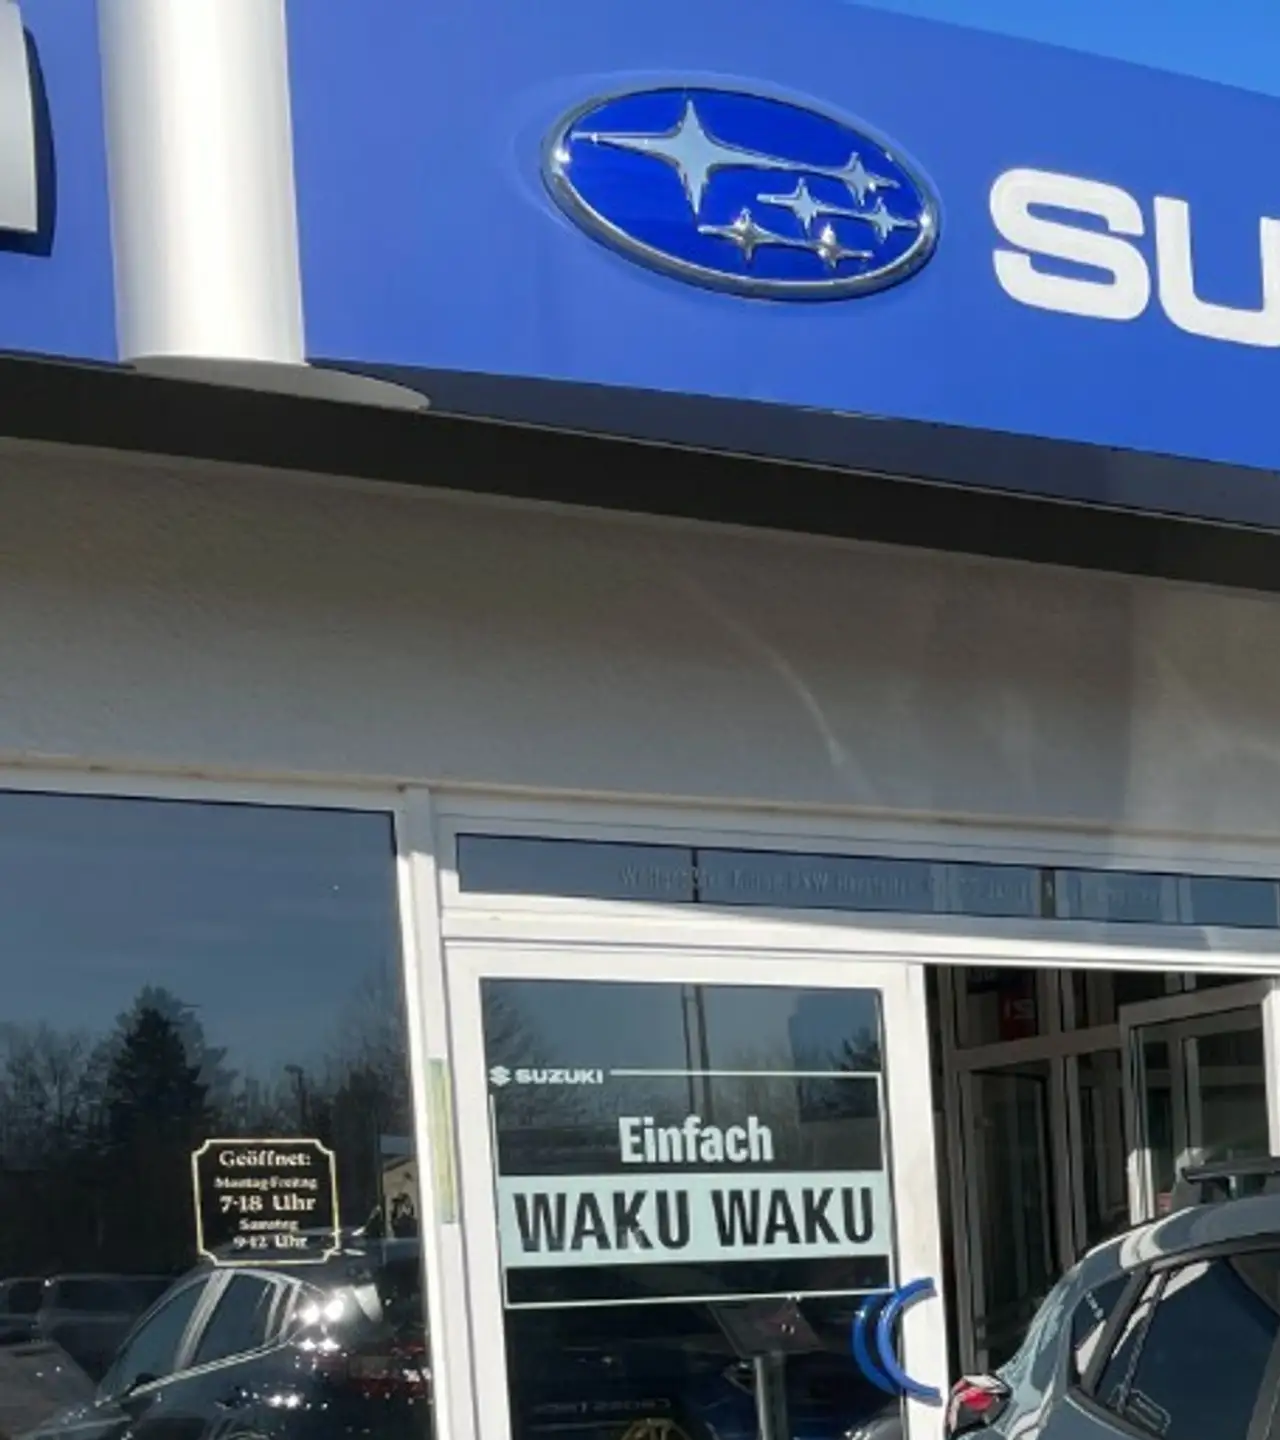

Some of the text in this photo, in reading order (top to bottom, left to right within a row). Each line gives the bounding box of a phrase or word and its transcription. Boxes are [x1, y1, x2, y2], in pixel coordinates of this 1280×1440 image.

[515, 1068, 604, 1085] SUZUKI
[618, 1115, 774, 1164] Einfach
[219, 1193, 317, 1213] 7-18 Uhr
[513, 1186, 875, 1253] WAKU WAKU
[274, 1234, 309, 1249] Uhr
